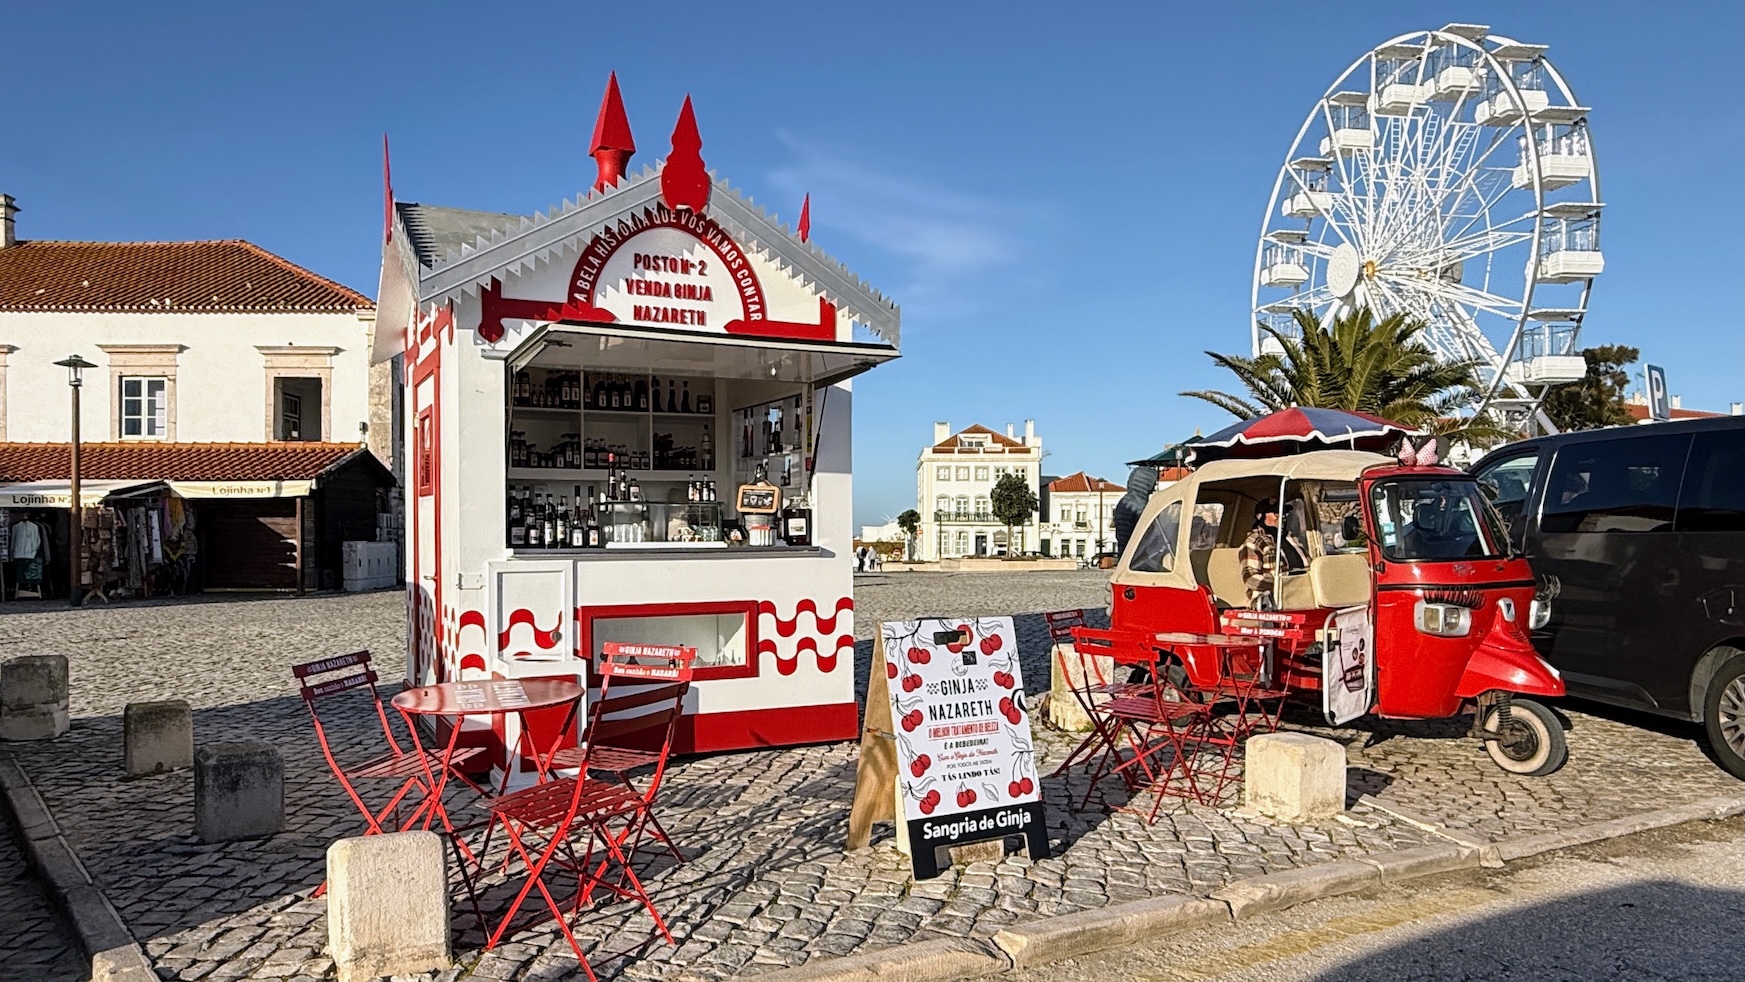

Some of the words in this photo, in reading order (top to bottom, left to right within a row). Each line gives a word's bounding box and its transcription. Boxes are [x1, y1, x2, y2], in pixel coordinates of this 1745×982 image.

[681, 211, 706, 233] VOS
[706, 227, 743, 269] VAMOS
[576, 255, 602, 290] BELA
[634, 253, 678, 274] POSTO
[574, 292, 588, 302] A
[625, 278, 672, 298] VENDA
[674, 283, 713, 302] GINJA
[736, 268, 763, 321] CONTAR
[633, 304, 706, 326] NAZARETH
[1651, 369, 1664, 414] P
[12, 494, 55, 505] Lojinha
[212, 486, 254, 496] Lojinha
[940, 678, 975, 696] GINJA
[928, 699, 993, 721] NAZARETH
[941, 771, 957, 782] TÁS
[958, 770, 982, 780] LINDO
[983, 766, 1001, 776] TÁS!
[923, 816, 978, 840] Sangria
[979, 815, 995, 831] de
[996, 808, 1032, 829] Ginja
